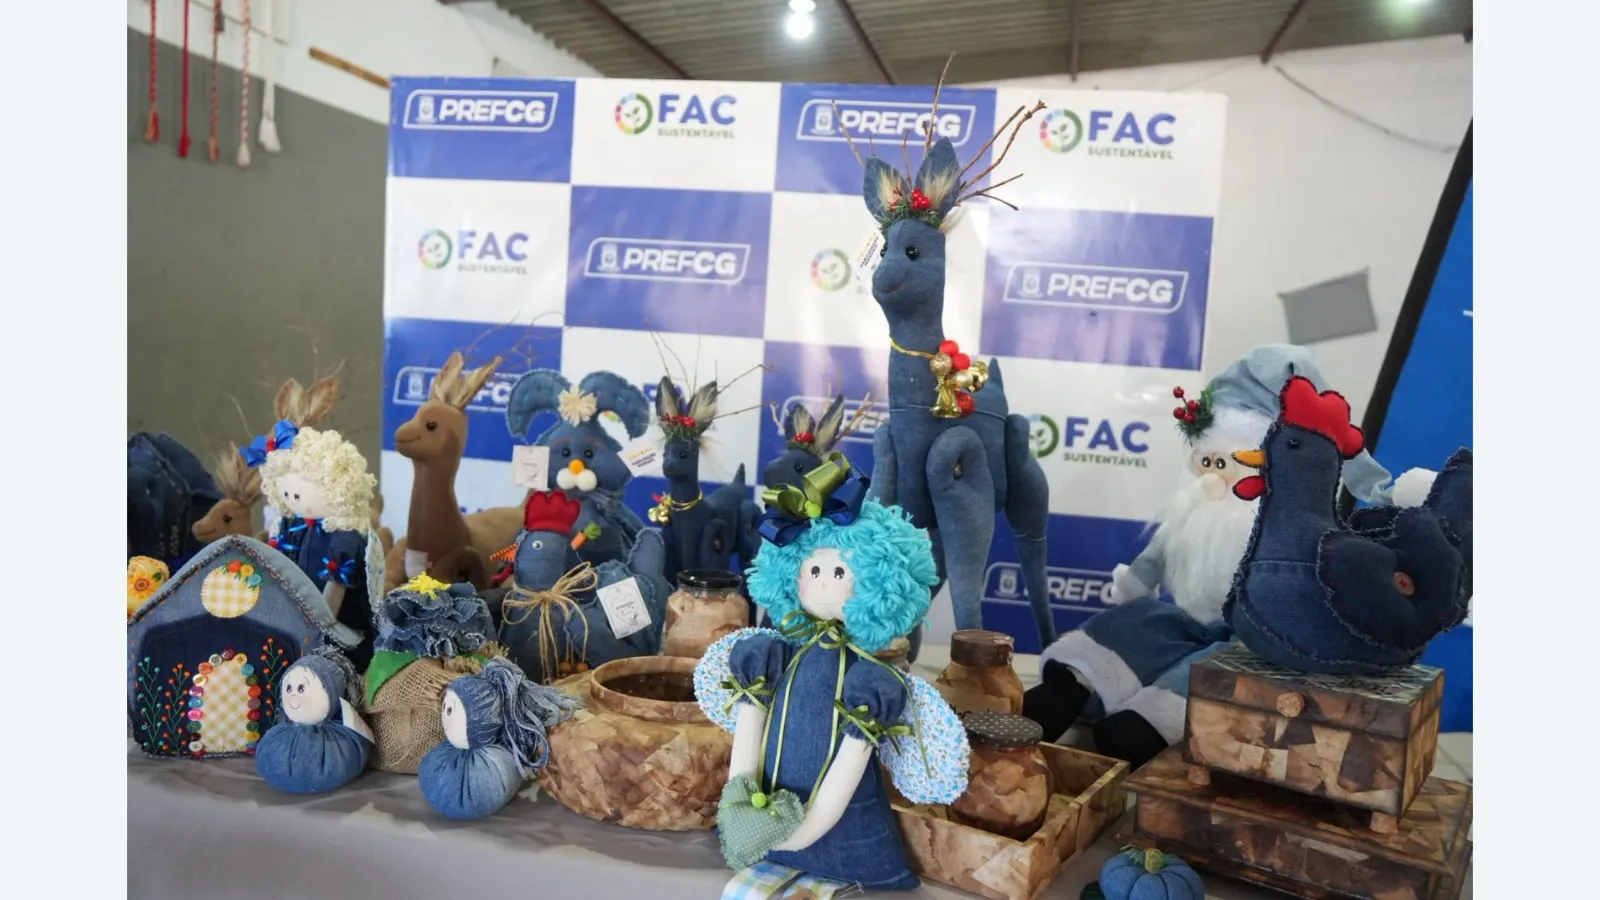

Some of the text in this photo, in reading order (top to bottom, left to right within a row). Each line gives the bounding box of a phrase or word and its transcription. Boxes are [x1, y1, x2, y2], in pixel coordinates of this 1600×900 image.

[439, 98, 546, 125] PREFCG
[658, 93, 738, 126] FAC
[840, 110, 962, 138] PREFCG
[657, 126, 736, 140] SUSTENTÁVEL
[1088, 111, 1177, 145] FAC
[1087, 146, 1174, 161] SUSTENTÁVEL
[457, 229, 530, 262] FAC
[457, 262, 529, 276] SUSTENTÁVEL
[623, 247, 738, 277] PREFCG
[1047, 273, 1175, 304] PREFCG
[1064, 416, 1153, 454] FAC
[1063, 451, 1149, 469] SUSTENTÁVEL
[1024, 576, 1117, 605] REFC
